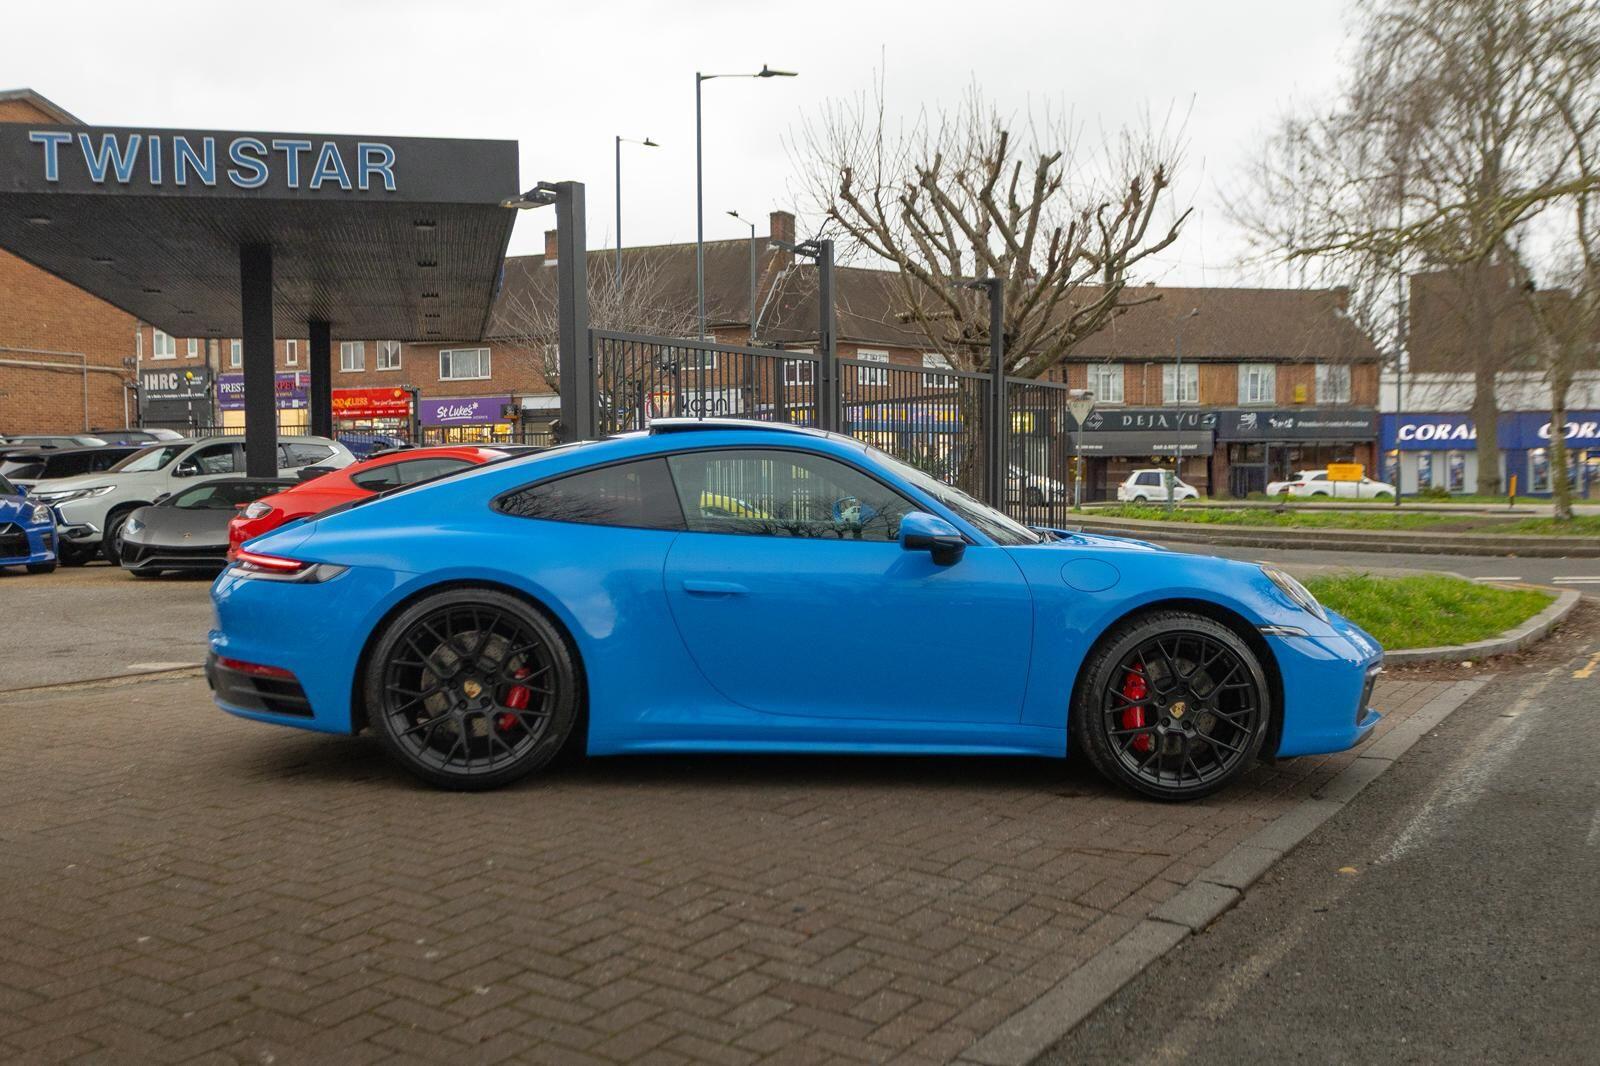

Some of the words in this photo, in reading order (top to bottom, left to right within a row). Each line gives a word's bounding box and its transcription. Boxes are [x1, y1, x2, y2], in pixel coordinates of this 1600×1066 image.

[28, 130, 397, 191] TWINSTAR
[144, 373, 178, 390] IHRC
[437, 406, 448, 418] St
[448, 404, 473, 417] Luke's
[1122, 414, 1169, 428] DEJA
[1537, 421, 1600, 439] COR
